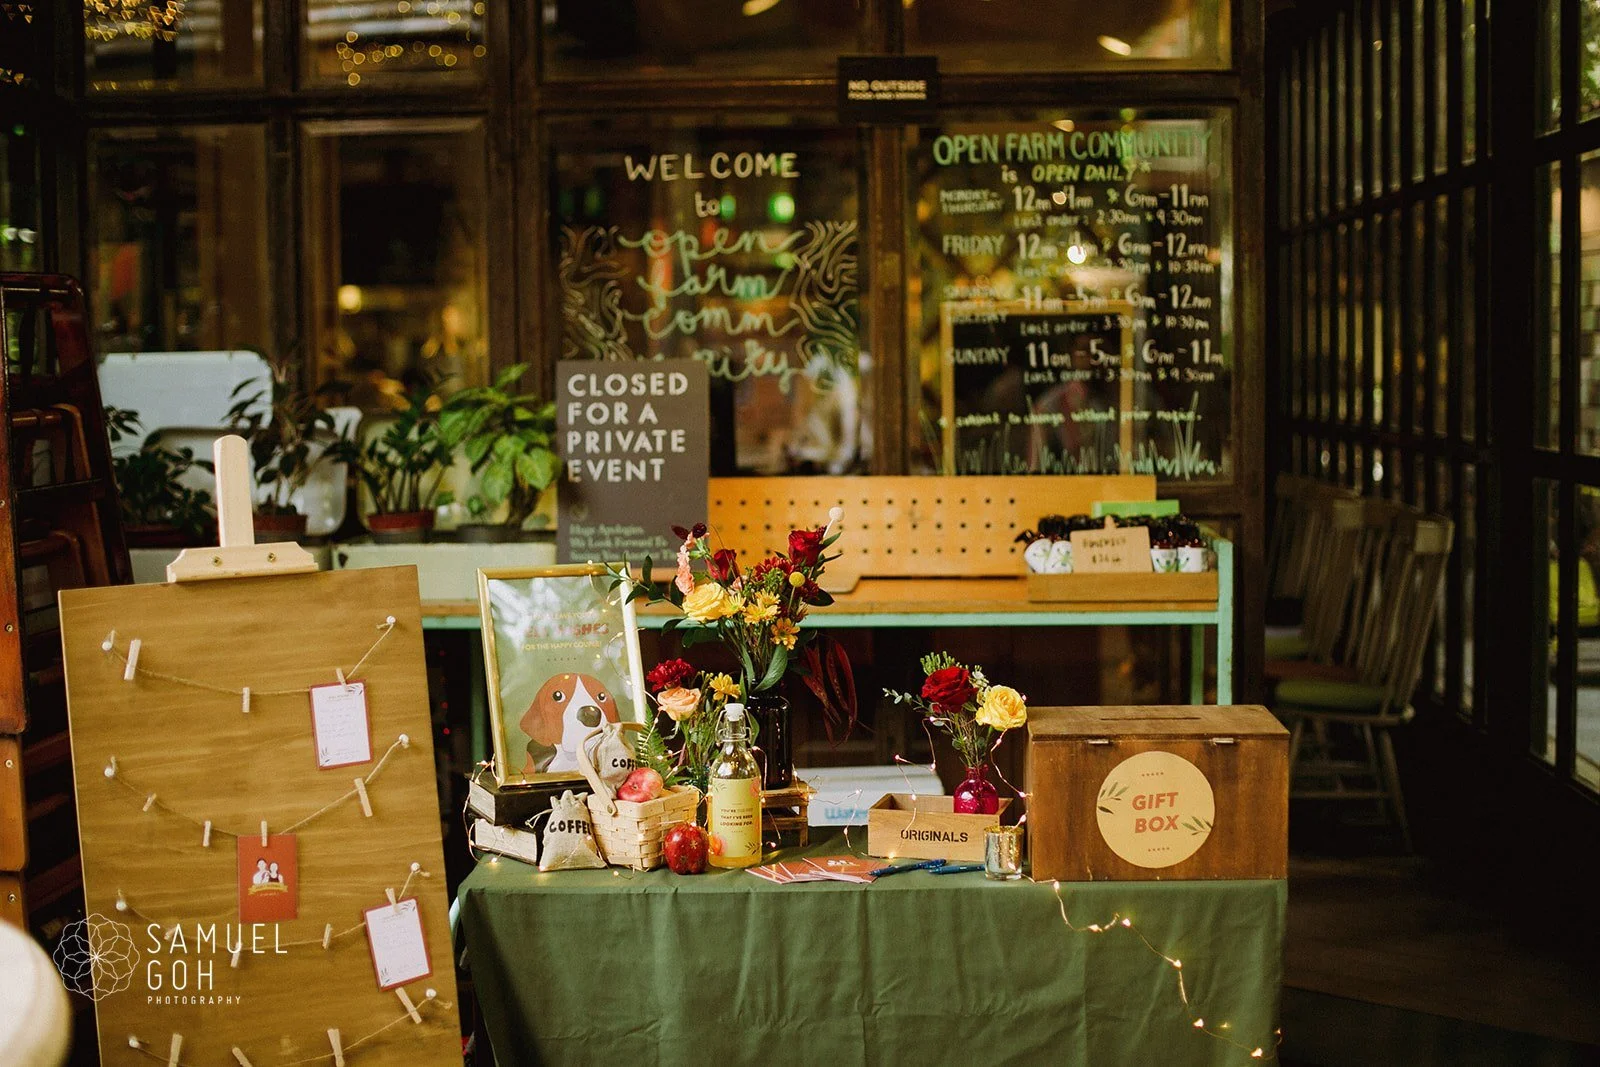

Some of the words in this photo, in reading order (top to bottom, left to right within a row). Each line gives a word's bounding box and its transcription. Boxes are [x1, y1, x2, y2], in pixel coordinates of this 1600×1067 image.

[932, 134, 999, 166] OPEN
[1005, 131, 1065, 163] FARM
[1070, 127, 1212, 161] COMMUNITY
[624, 152, 800, 182] WELCOME
[1001, 164, 1018, 184] is
[1031, 163, 1080, 183] OPEN
[695, 192, 720, 218] to
[619, 228, 805, 278] open
[942, 234, 1006, 256] FRIDAY
[945, 346, 1010, 366] SUNDAY
[567, 372, 688, 397] CLOSED
[567, 401, 629, 425] FOR
[638, 402, 658, 425] A
[567, 429, 686, 455] PRIVATE
[567, 458, 665, 483] EVENT
[1132, 792, 1178, 811] GIFT
[900, 828, 968, 843] ORIGINALS
[1135, 814, 1180, 834] BOX
